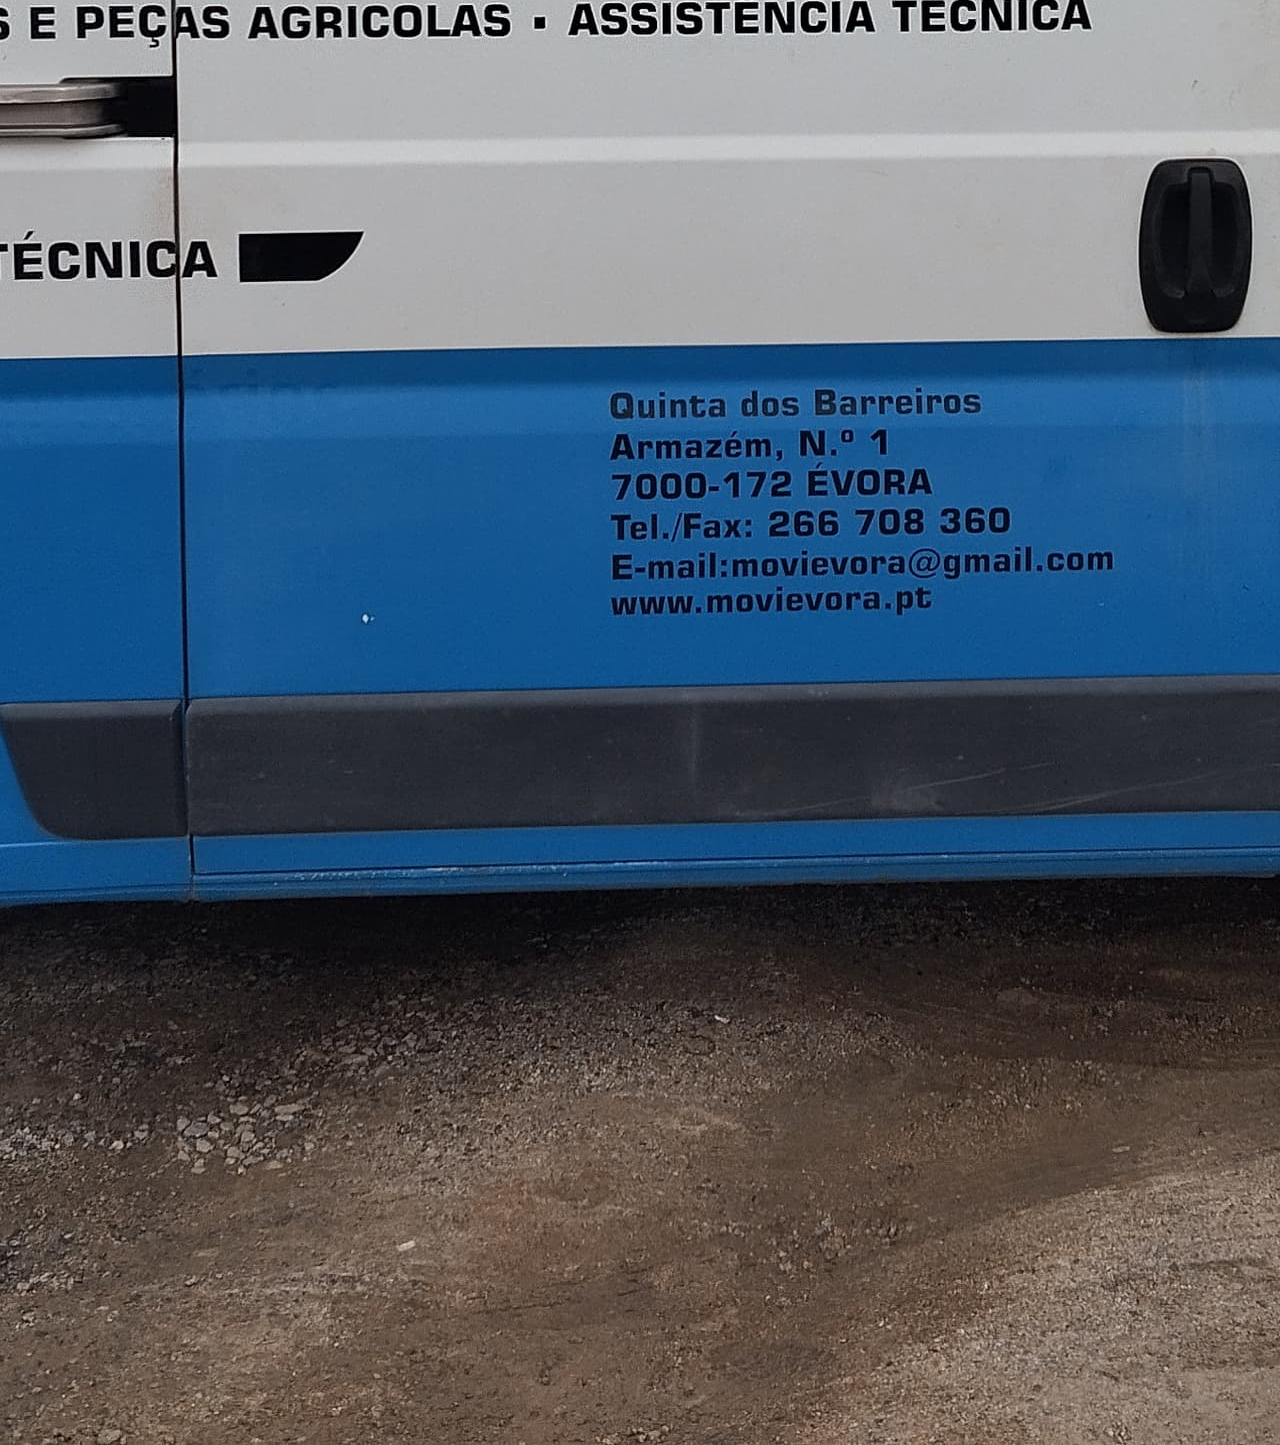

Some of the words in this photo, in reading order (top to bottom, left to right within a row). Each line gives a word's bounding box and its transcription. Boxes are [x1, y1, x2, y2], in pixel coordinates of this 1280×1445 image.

[30, 6, 56, 40] E
[76, 4, 230, 50] PEÇAS
[247, 3, 511, 39] AGRICOLAS
[609, 392, 726, 420] Quinta
[741, 391, 800, 416] dos
[814, 388, 982, 416] Barreiros
[610, 431, 785, 461] Armazém,
[872, 429, 888, 455] 1
[611, 471, 793, 500] 7000-172
[807, 463, 933, 497] ÉVORA
[611, 512, 753, 542] Tel./Fax:
[768, 510, 839, 537] 266
[855, 508, 925, 535] 708
[940, 507, 1011, 534] 360
[611, 547, 1114, 581] E-mail:movievora@gmail.com
[611, 587, 933, 616] www.movievora.pt
